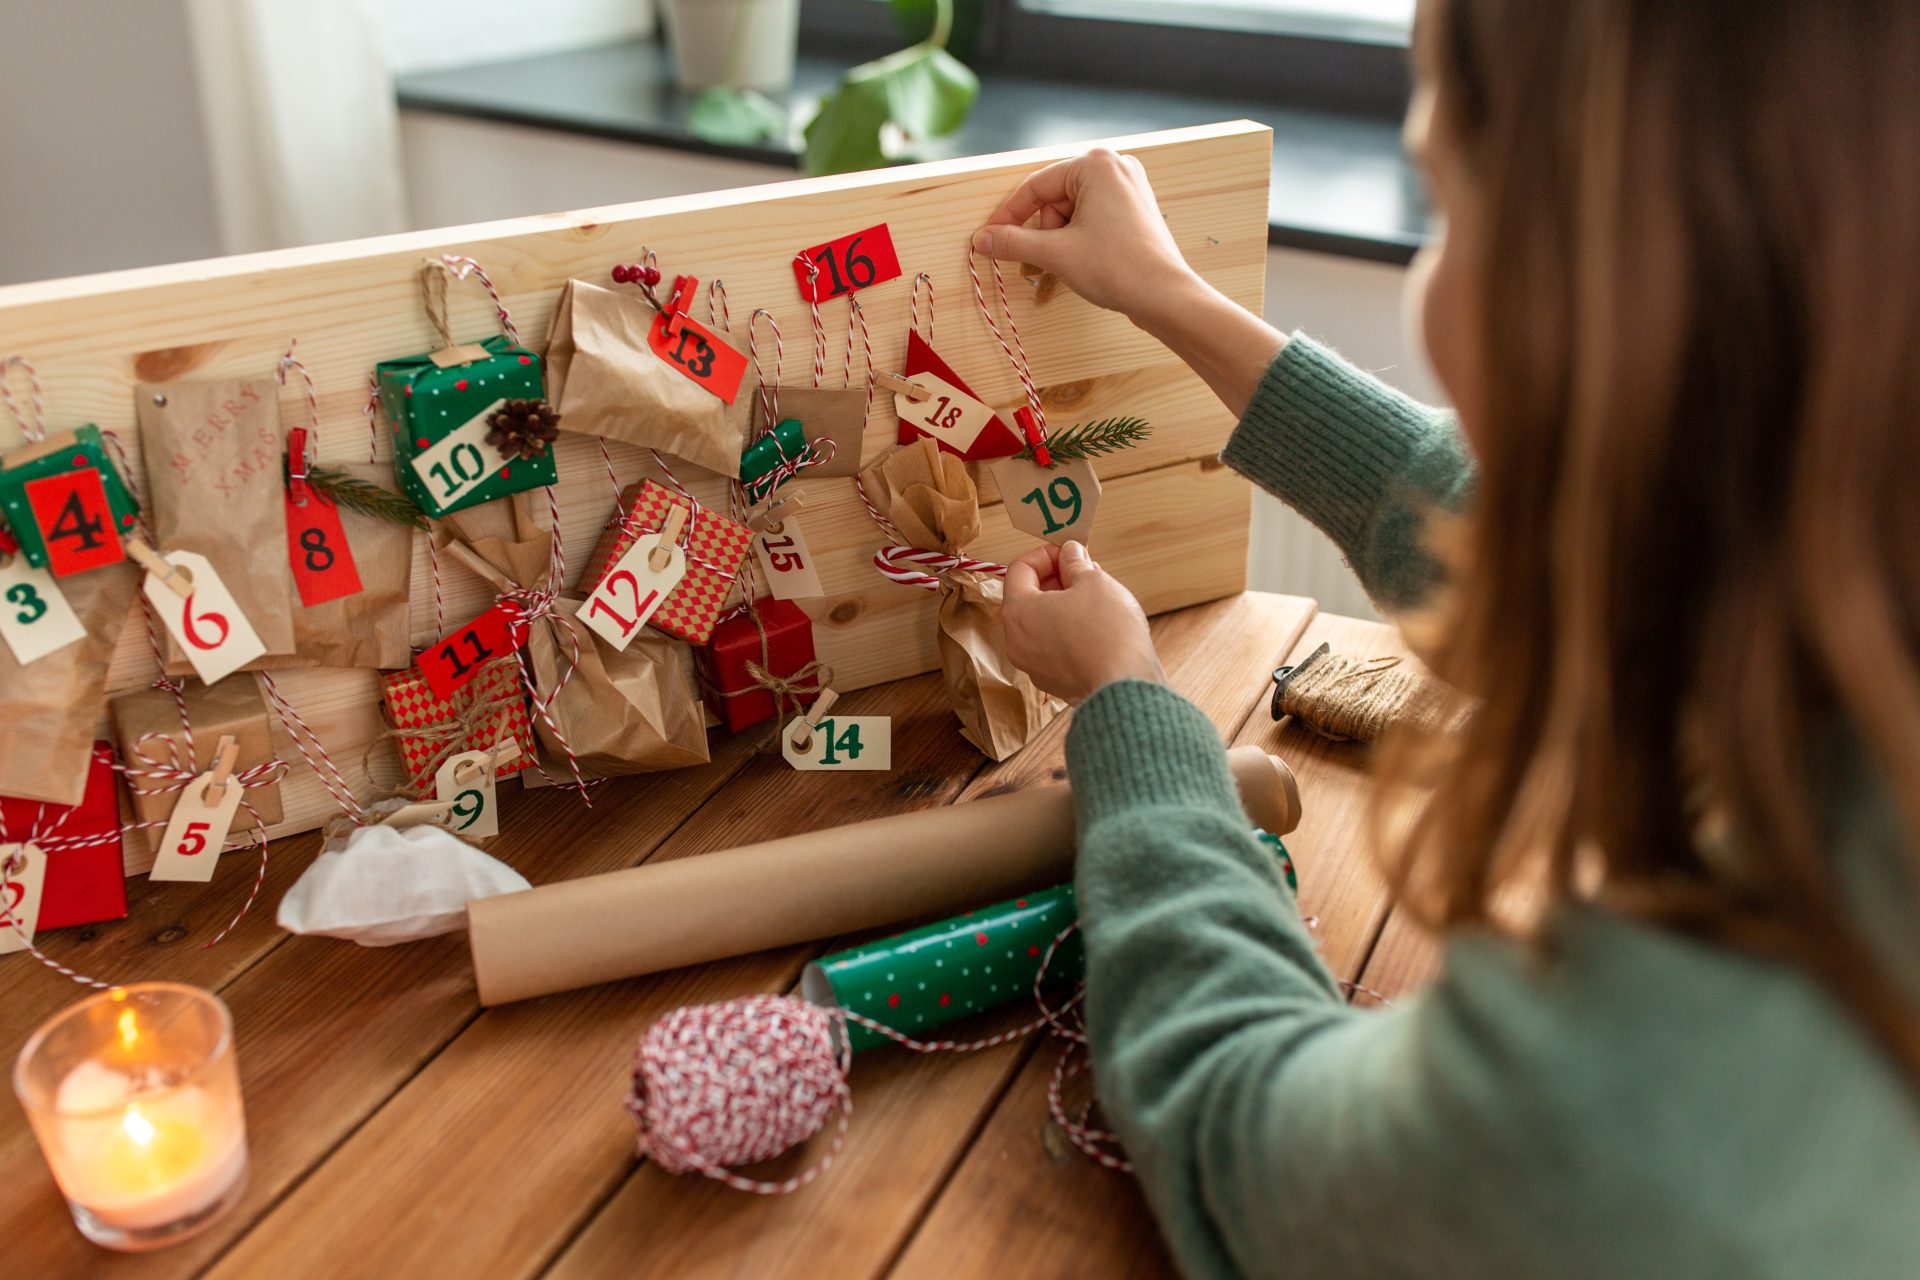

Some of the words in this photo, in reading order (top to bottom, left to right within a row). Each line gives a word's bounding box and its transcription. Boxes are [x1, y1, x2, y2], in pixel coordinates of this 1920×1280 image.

[816, 237, 876, 296] 16
[669, 327, 716, 378] 13
[169, 386, 262, 486] MERRY
[924, 396, 963, 429] 18
[214, 427, 277, 498] XMAS
[429, 442, 485, 498] 10
[47, 490, 104, 553] 4
[1021, 476, 1083, 536] 19
[300, 528, 335, 571] 8
[761, 535, 804, 572] 15
[6, 583, 48, 625] 3
[182, 592, 230, 651] 6
[589, 569, 659, 639] 12
[440, 630, 495, 680] 11
[813, 718, 864, 766] 14
[452, 789, 485, 832] 9
[177, 822, 211, 856] 5
